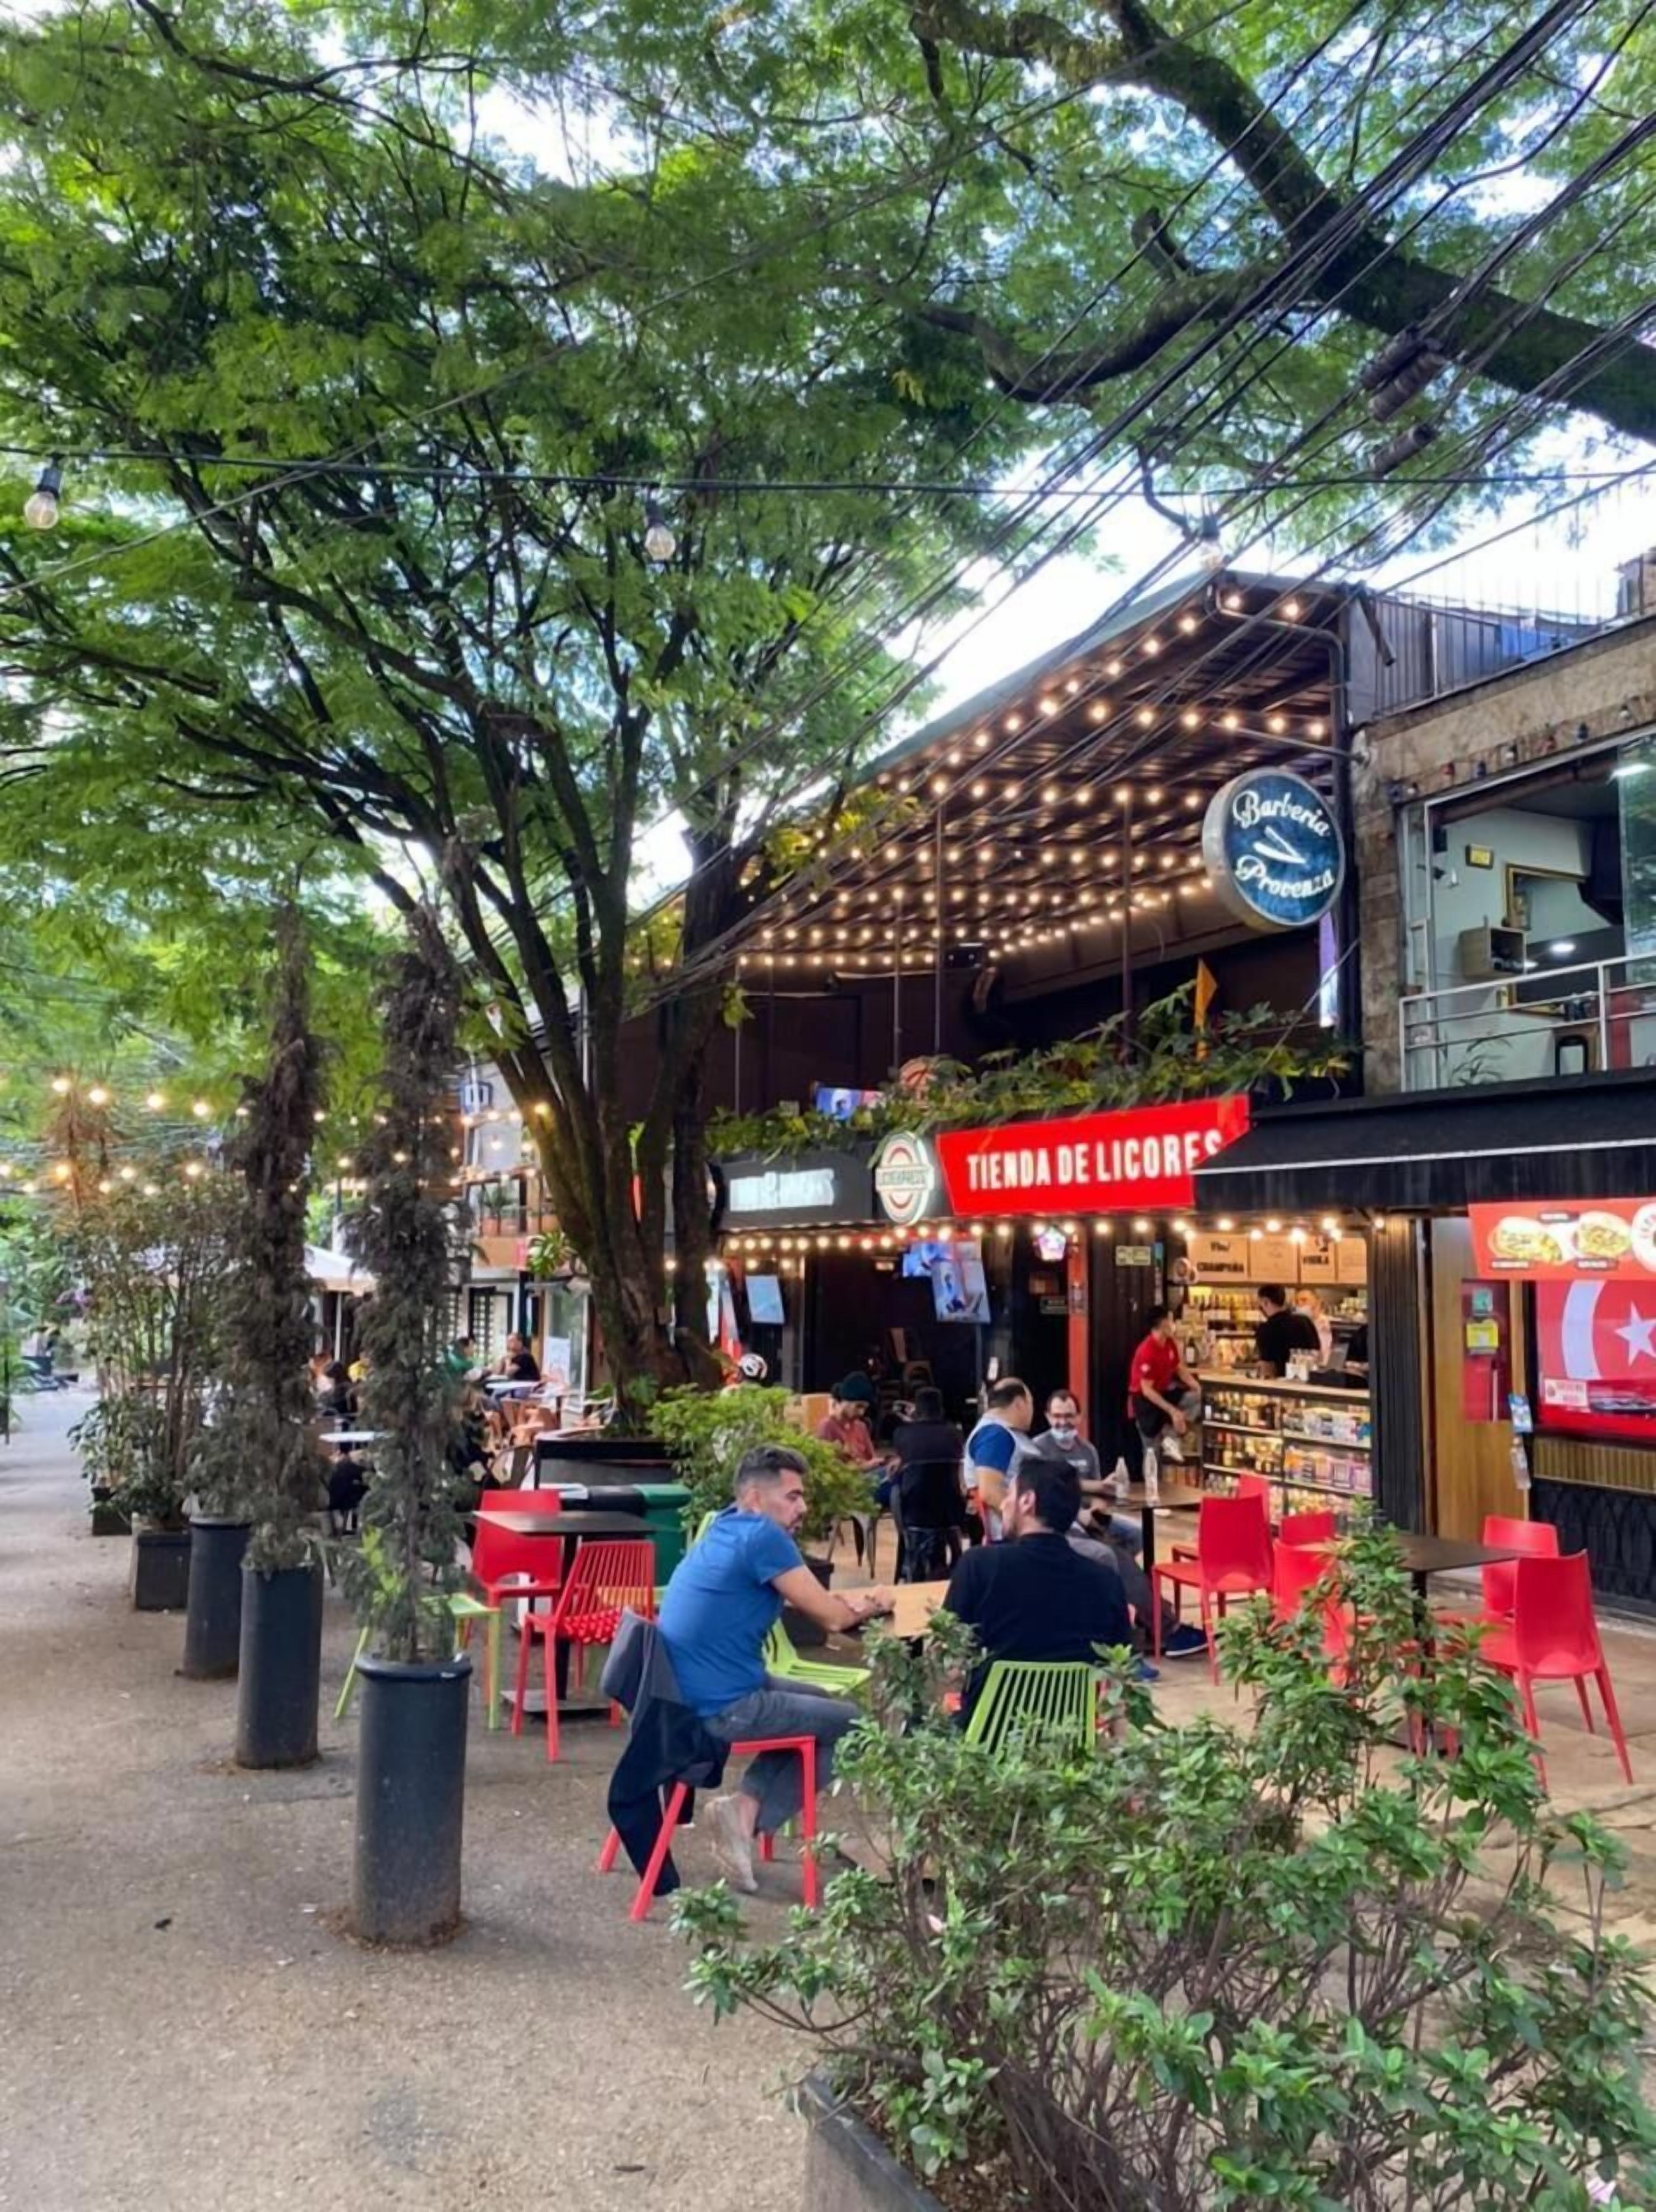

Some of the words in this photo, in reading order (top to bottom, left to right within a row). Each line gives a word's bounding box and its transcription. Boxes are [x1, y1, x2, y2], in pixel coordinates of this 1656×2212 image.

[1235, 854, 1334, 898] Provenza
[967, 1147, 1051, 1191] TIENDA
[1058, 1142, 1089, 1185] DE
[1096, 1129, 1223, 1180] LICORES
